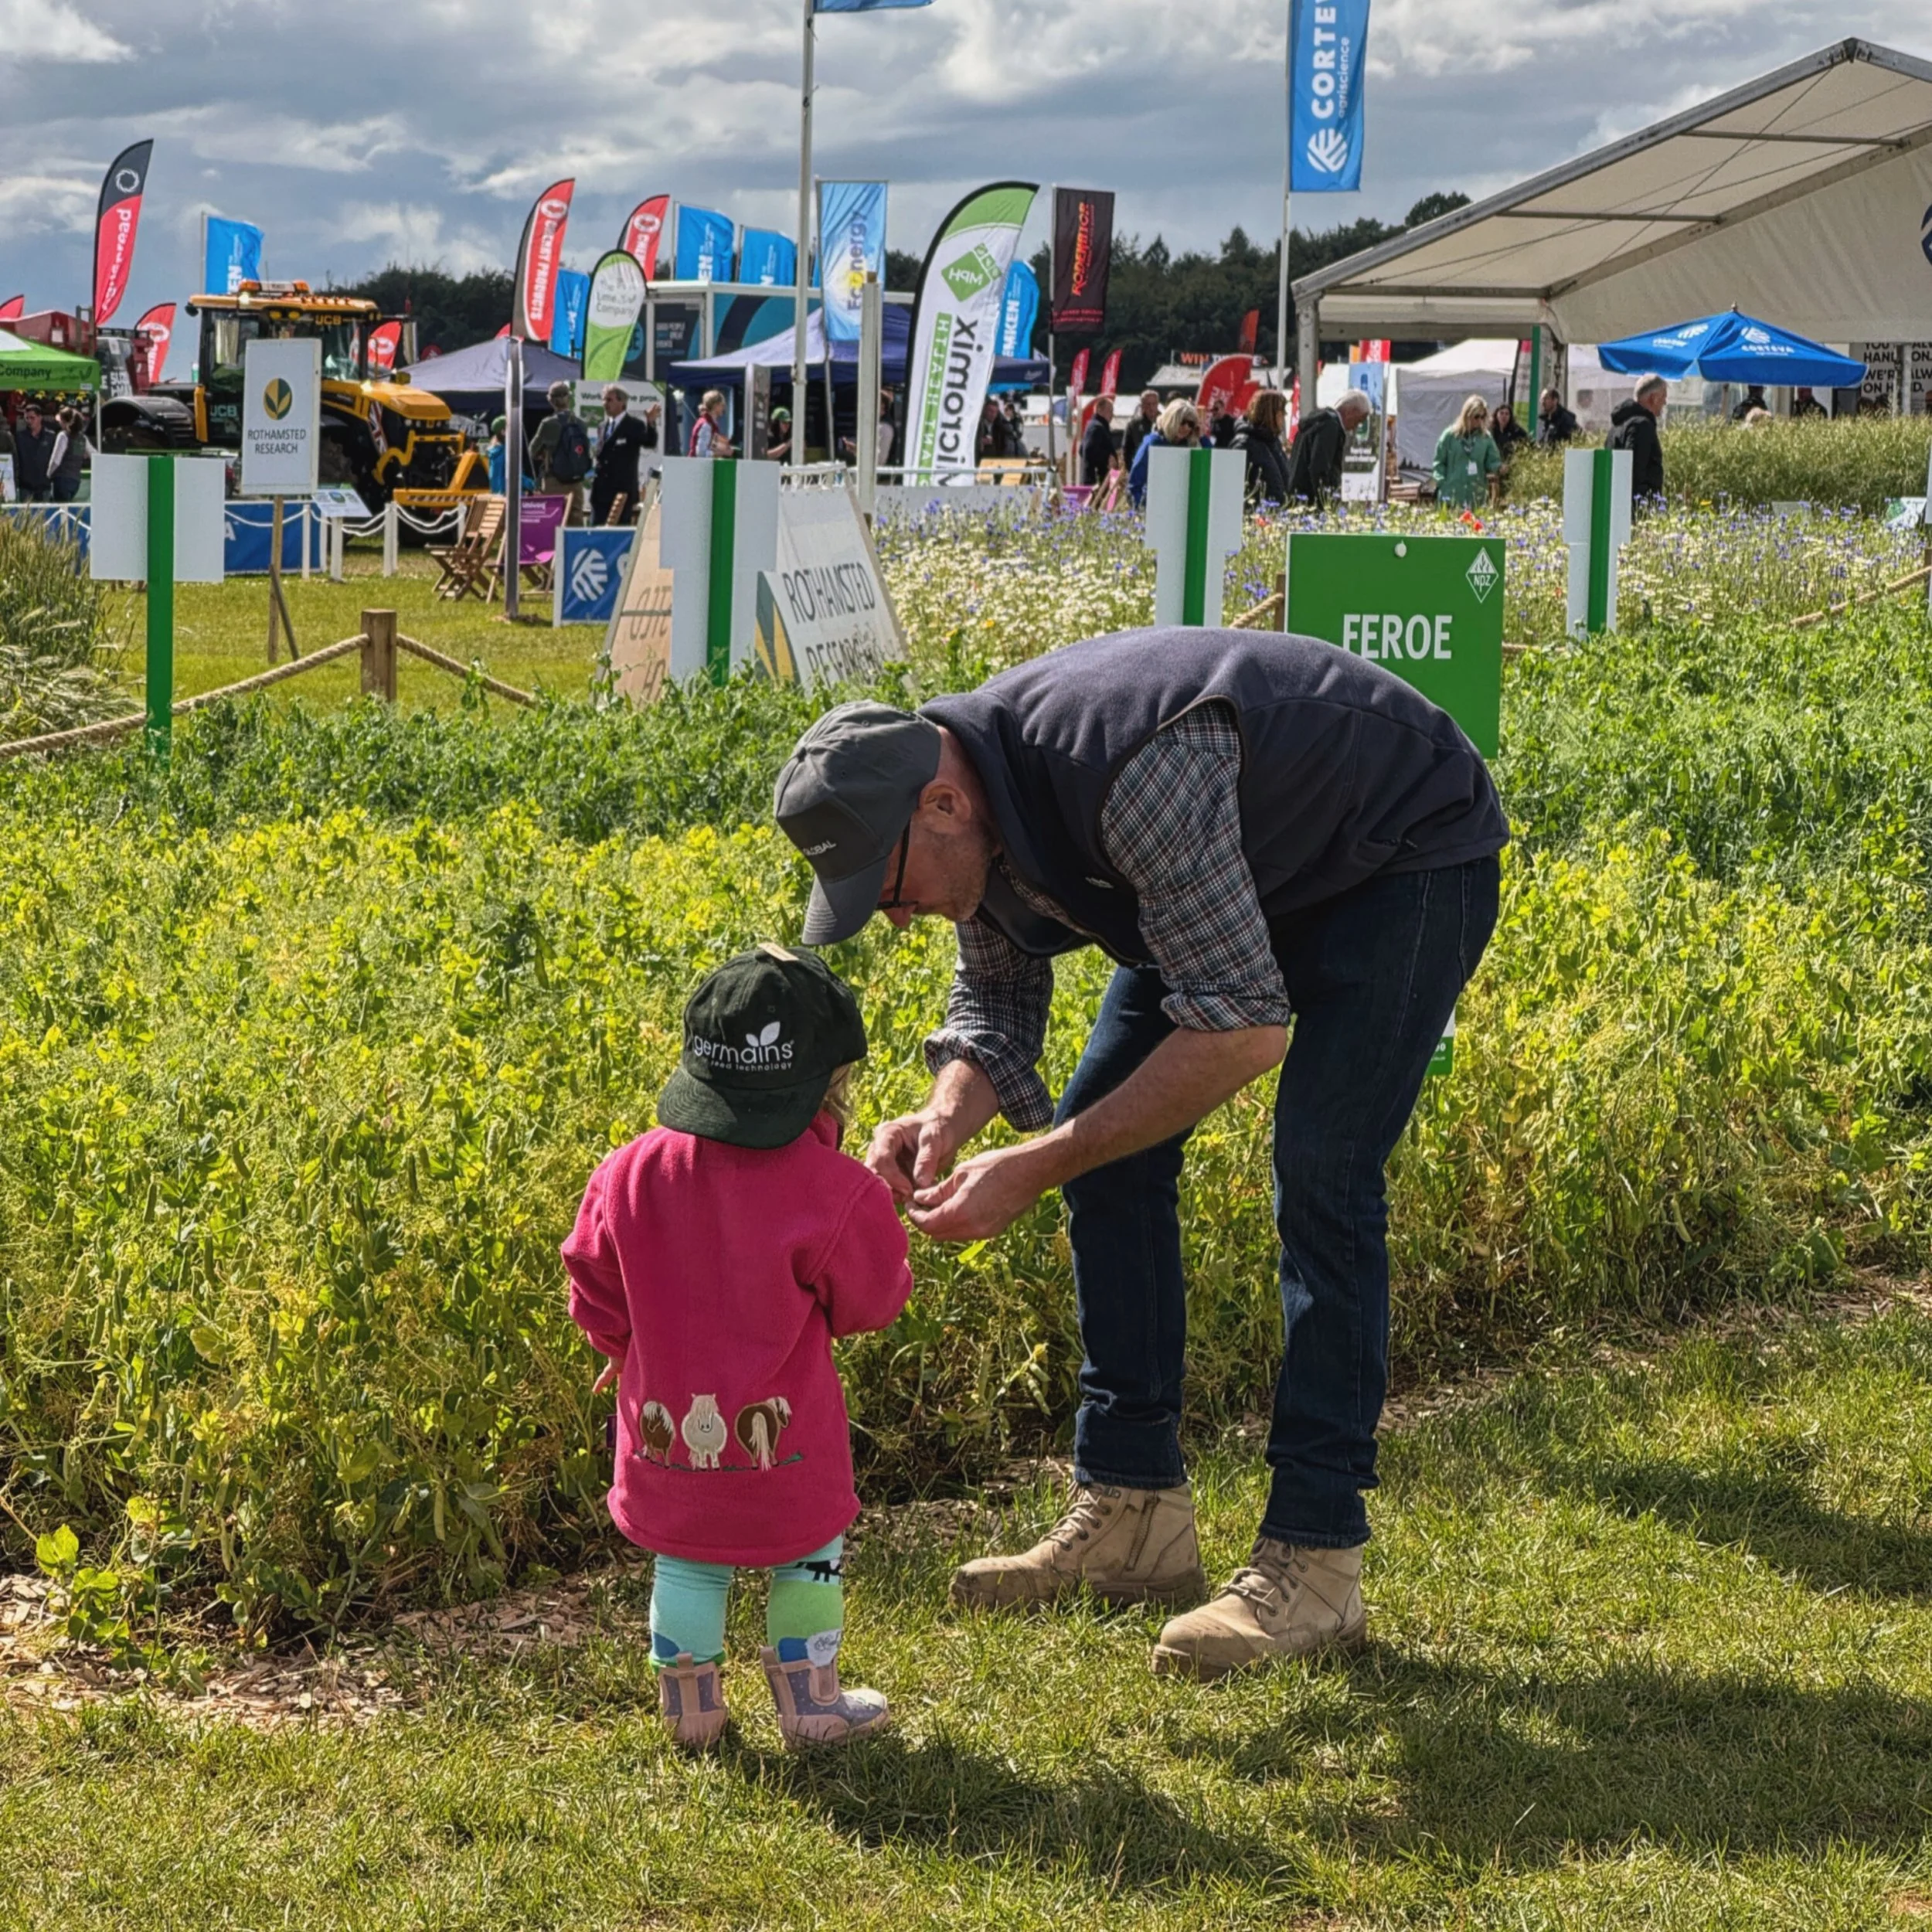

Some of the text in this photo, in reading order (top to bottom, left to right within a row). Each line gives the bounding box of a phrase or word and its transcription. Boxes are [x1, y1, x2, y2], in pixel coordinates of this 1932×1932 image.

[1311, 0, 1336, 119] CORTE
[1337, 36, 1350, 119] agriscience
[315, 315, 342, 325] JCB
[1002, 298, 1021, 358] EMKEN
[1741, 345, 1794, 353] CORTEVA
[1863, 382, 1882, 393] ON
[209, 404, 237, 417] JCB
[247, 429, 306, 440] ROTHAMSTED
[254, 443, 298, 454] RESEARCH
[781, 561, 876, 624] ROTHAMSTED
[1342, 614, 1453, 659] FEROE
[694, 1035, 794, 1064] germains
[710, 1060, 792, 1072] seed technology
